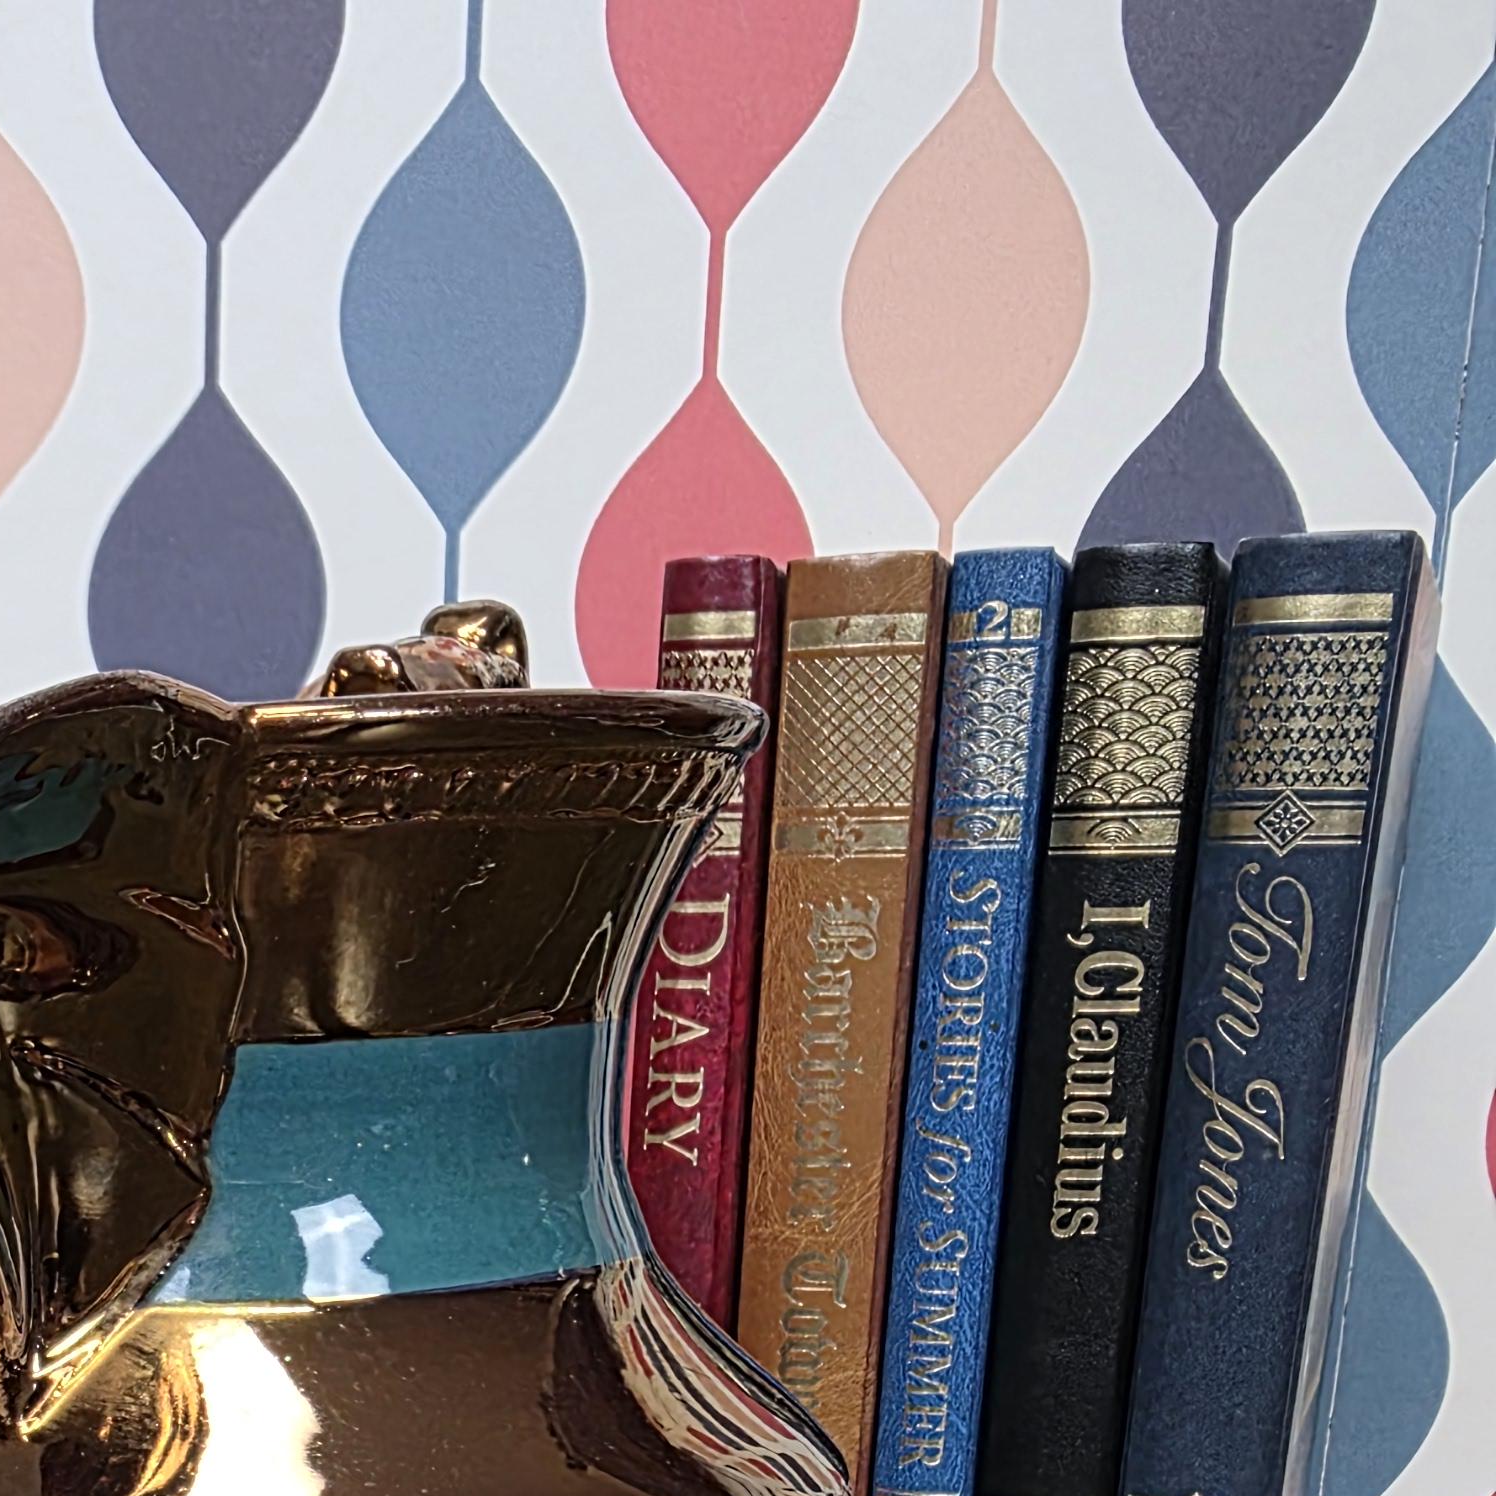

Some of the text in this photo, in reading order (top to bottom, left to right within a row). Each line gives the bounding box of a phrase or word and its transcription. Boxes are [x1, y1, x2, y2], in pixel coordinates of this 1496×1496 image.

[978, 600, 1008, 640] 2
[644, 893, 730, 1166] DIARY
[786, 895, 880, 1232] Barchester
[898, 869, 1001, 1467] STORIES for SUMMER
[1050, 950, 1145, 1239] Claudius
[1185, 862, 1313, 1280] Tom Jones
